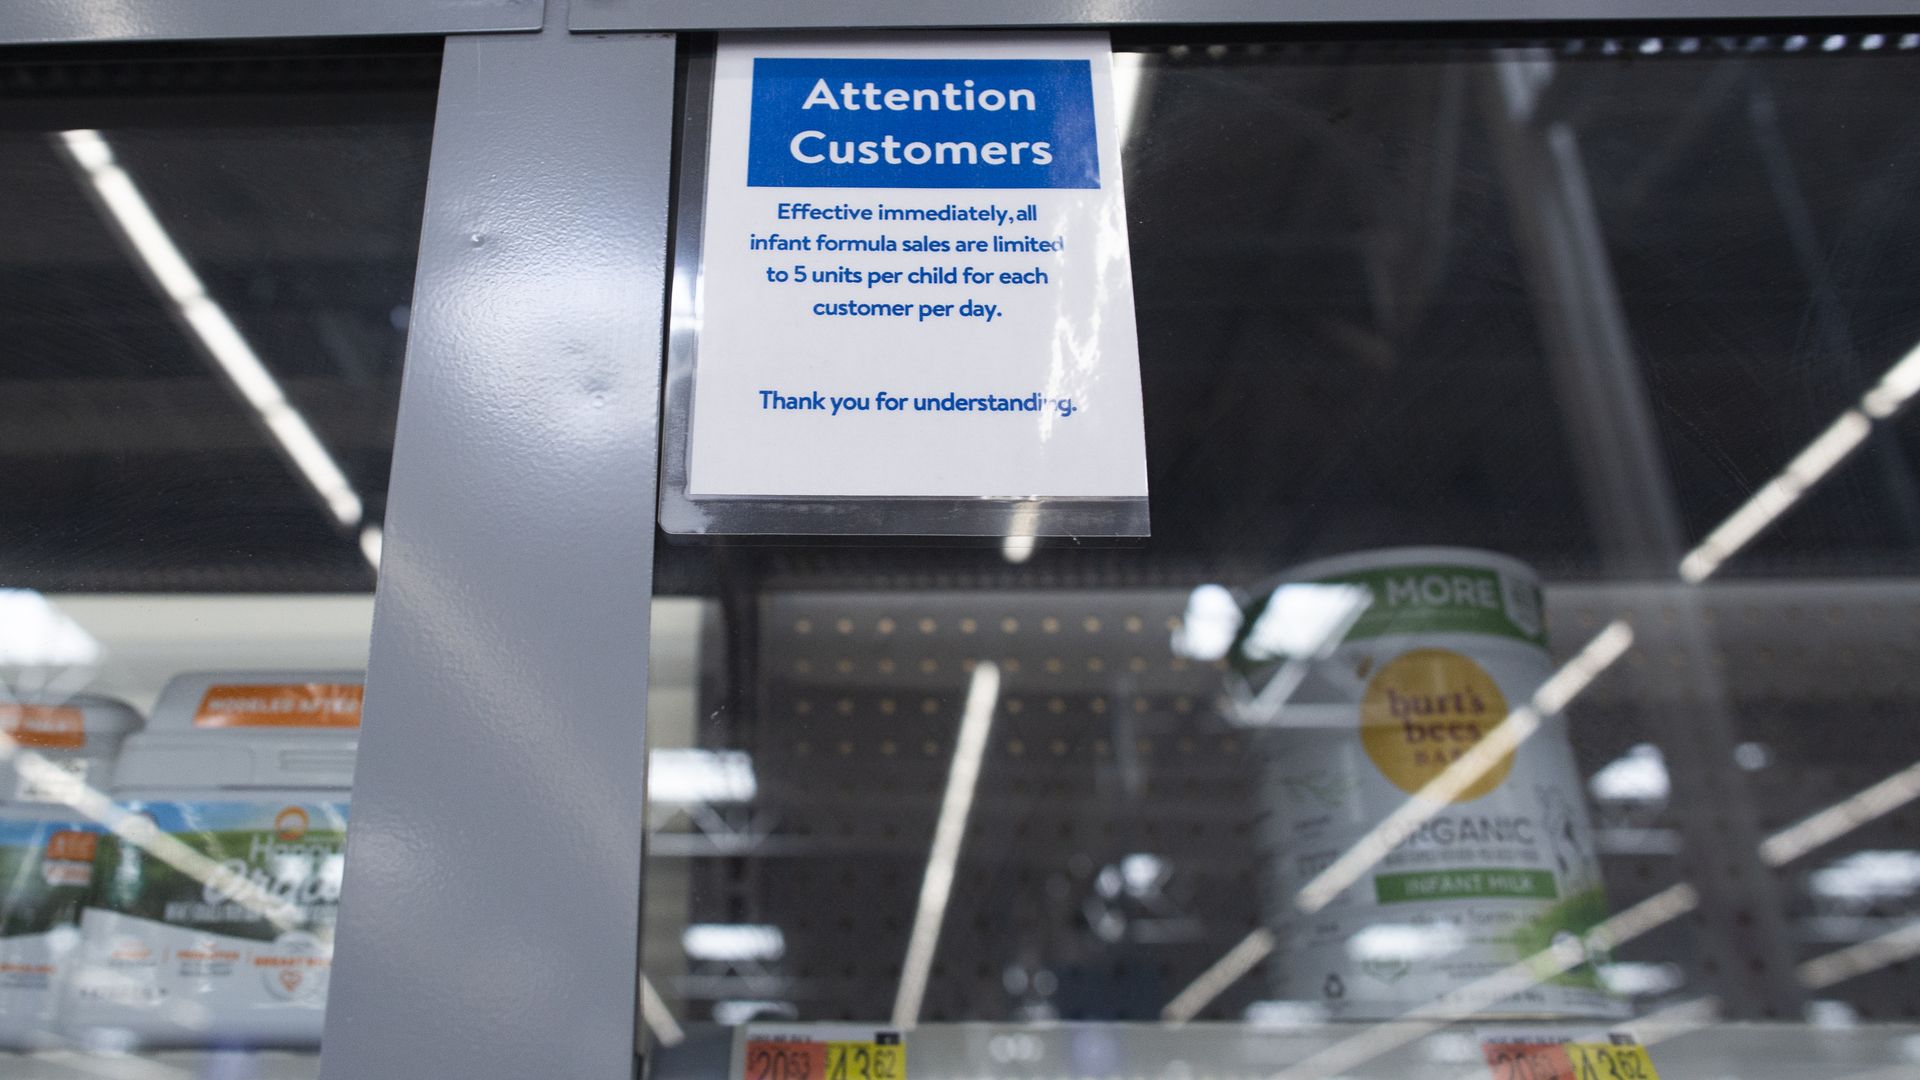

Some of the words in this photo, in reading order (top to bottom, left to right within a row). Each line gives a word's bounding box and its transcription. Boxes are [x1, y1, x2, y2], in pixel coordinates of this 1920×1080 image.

[802, 78, 1036, 111] Attention
[790, 130, 1053, 165] Customers
[777, 202, 873, 220] Effective
[750, 233, 812, 251] infant
[816, 233, 898, 252] formula
[902, 235, 951, 252] sales
[955, 239, 989, 252] are
[993, 235, 1064, 252] limited
[766, 266, 789, 283] to
[793, 265, 808, 283] 5
[812, 265, 863, 283] units
[867, 271, 903, 289] per
[907, 266, 958, 284] child
[962, 266, 995, 284] for
[999, 266, 1049, 284] each
[812, 300, 914, 317] customer
[918, 304, 955, 322] per
[958, 298, 1003, 322] day.
[759, 390, 826, 410] Thank
[830, 396, 870, 416] you
[875, 391, 909, 411] for
[1386, 574, 1499, 608] MORE
